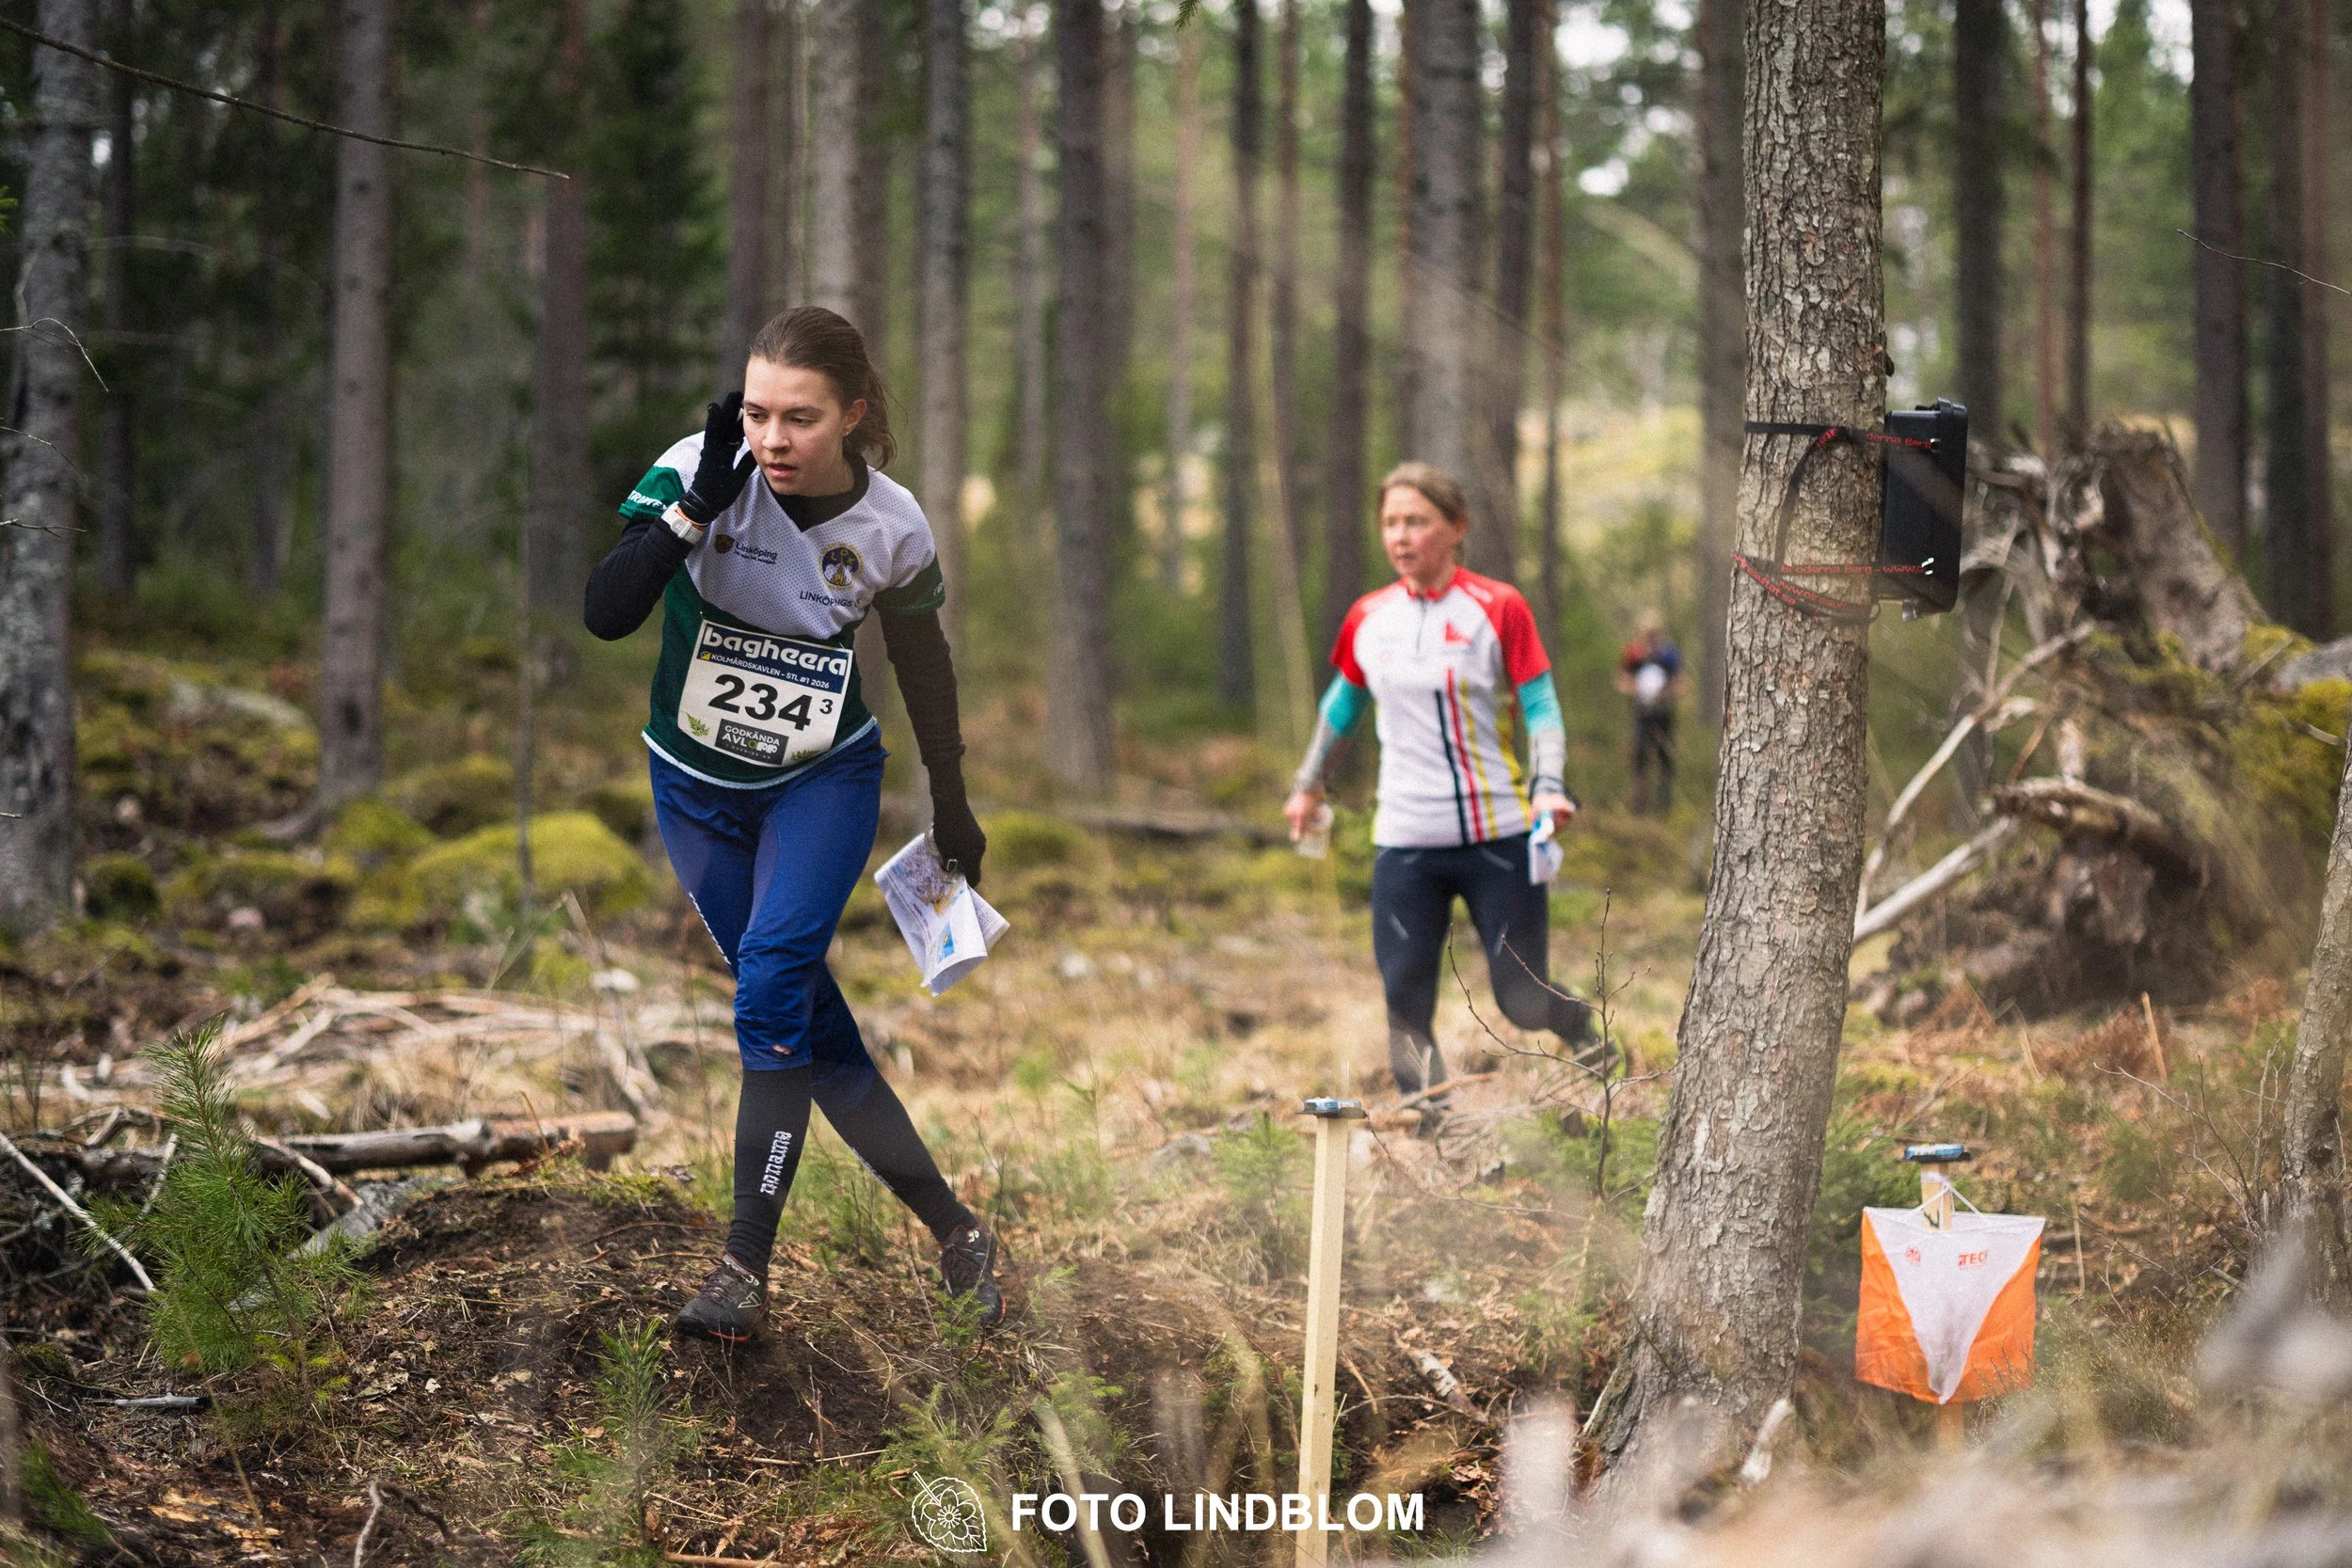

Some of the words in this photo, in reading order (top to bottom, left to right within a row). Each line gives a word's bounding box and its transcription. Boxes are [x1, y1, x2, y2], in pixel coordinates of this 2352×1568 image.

[736, 542, 778, 562] Linköping
[703, 626, 848, 677] bagheera
[710, 653, 781, 678] KOLMÅRDSKAVLEN
[786, 672, 799, 682] STL
[799, 676, 810, 686] #1
[811, 679, 830, 689] 2026
[707, 673, 813, 732] 234
[819, 698, 834, 715] 3
[724, 725, 780, 746] GODKÄNDA
[759, 1131, 792, 1196] noname
